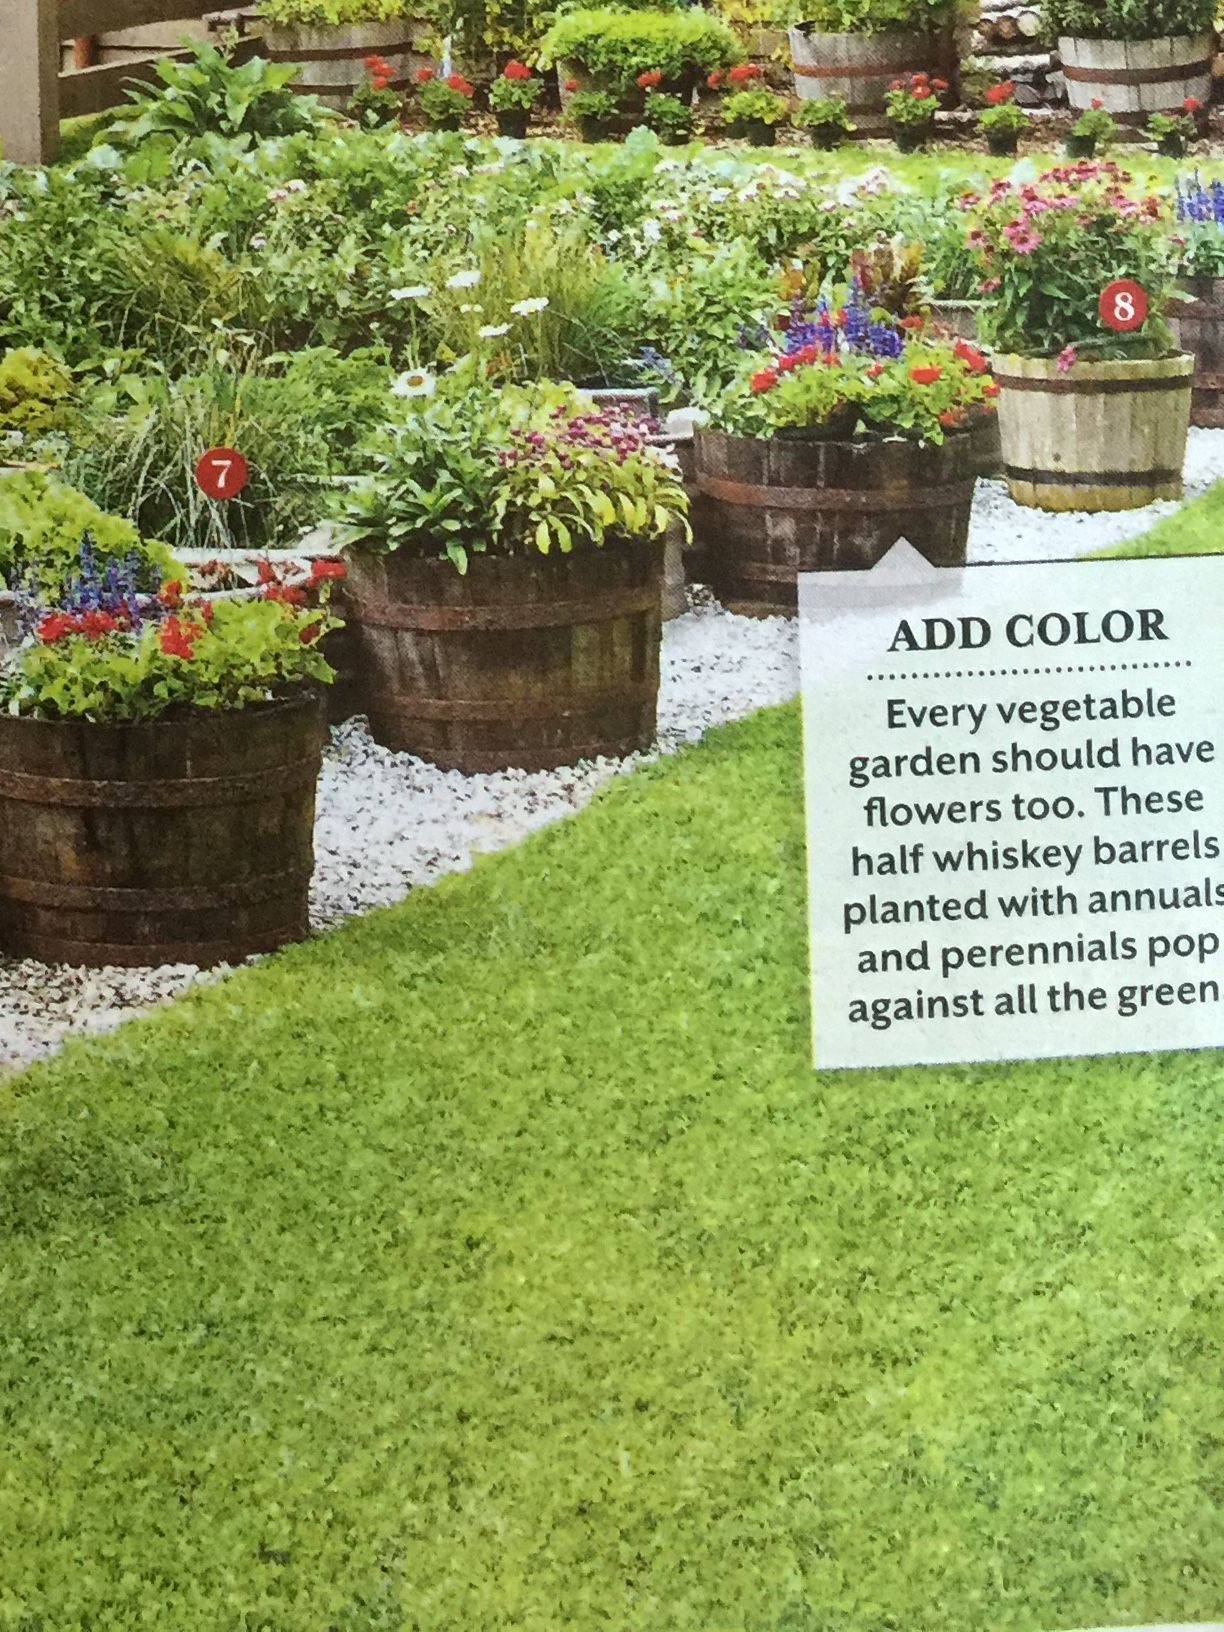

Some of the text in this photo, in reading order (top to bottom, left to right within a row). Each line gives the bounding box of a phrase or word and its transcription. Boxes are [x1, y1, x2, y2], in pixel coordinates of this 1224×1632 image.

[1114, 292, 1135, 322] 8
[211, 459, 232, 489] 7
[886, 608, 1170, 653] ADD COLOR
[886, 687, 1176, 735] Every vegetable
[849, 736, 1215, 789] garden should have
[862, 785, 1204, 828] flowers too. These
[851, 829, 1220, 877] half whiskey barrels
[843, 876, 1224, 935] planted with annuals
[857, 930, 1220, 979] and perennials pop
[848, 980, 1224, 1031] against all the green
